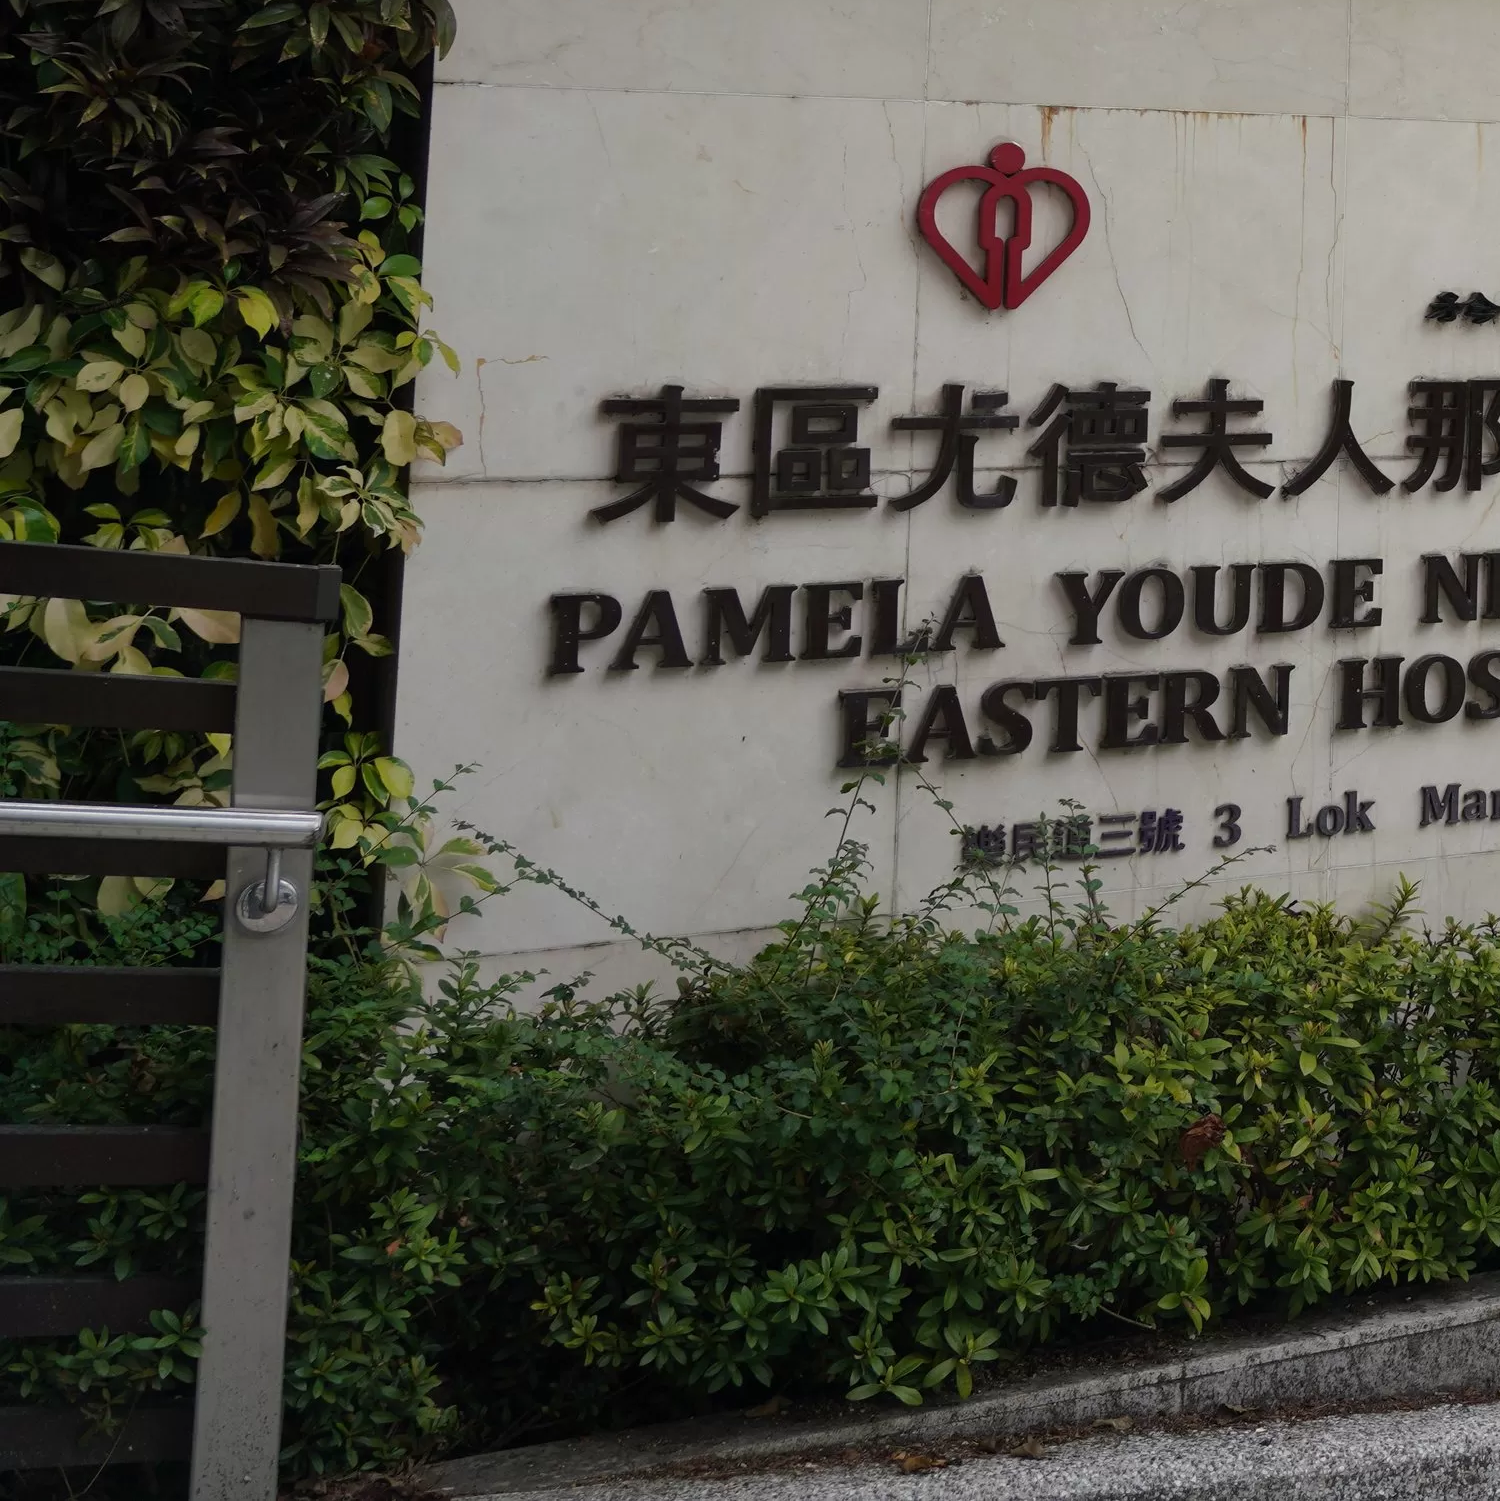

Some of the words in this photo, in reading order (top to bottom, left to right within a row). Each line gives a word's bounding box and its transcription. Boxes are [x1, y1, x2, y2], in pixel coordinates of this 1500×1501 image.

[550, 573, 1006, 675] PAMELA
[1055, 558, 1384, 646] YOUDE
[836, 663, 1297, 769] EASTERN
[1213, 803, 1243, 849] 3
[1286, 790, 1376, 841] Lok
